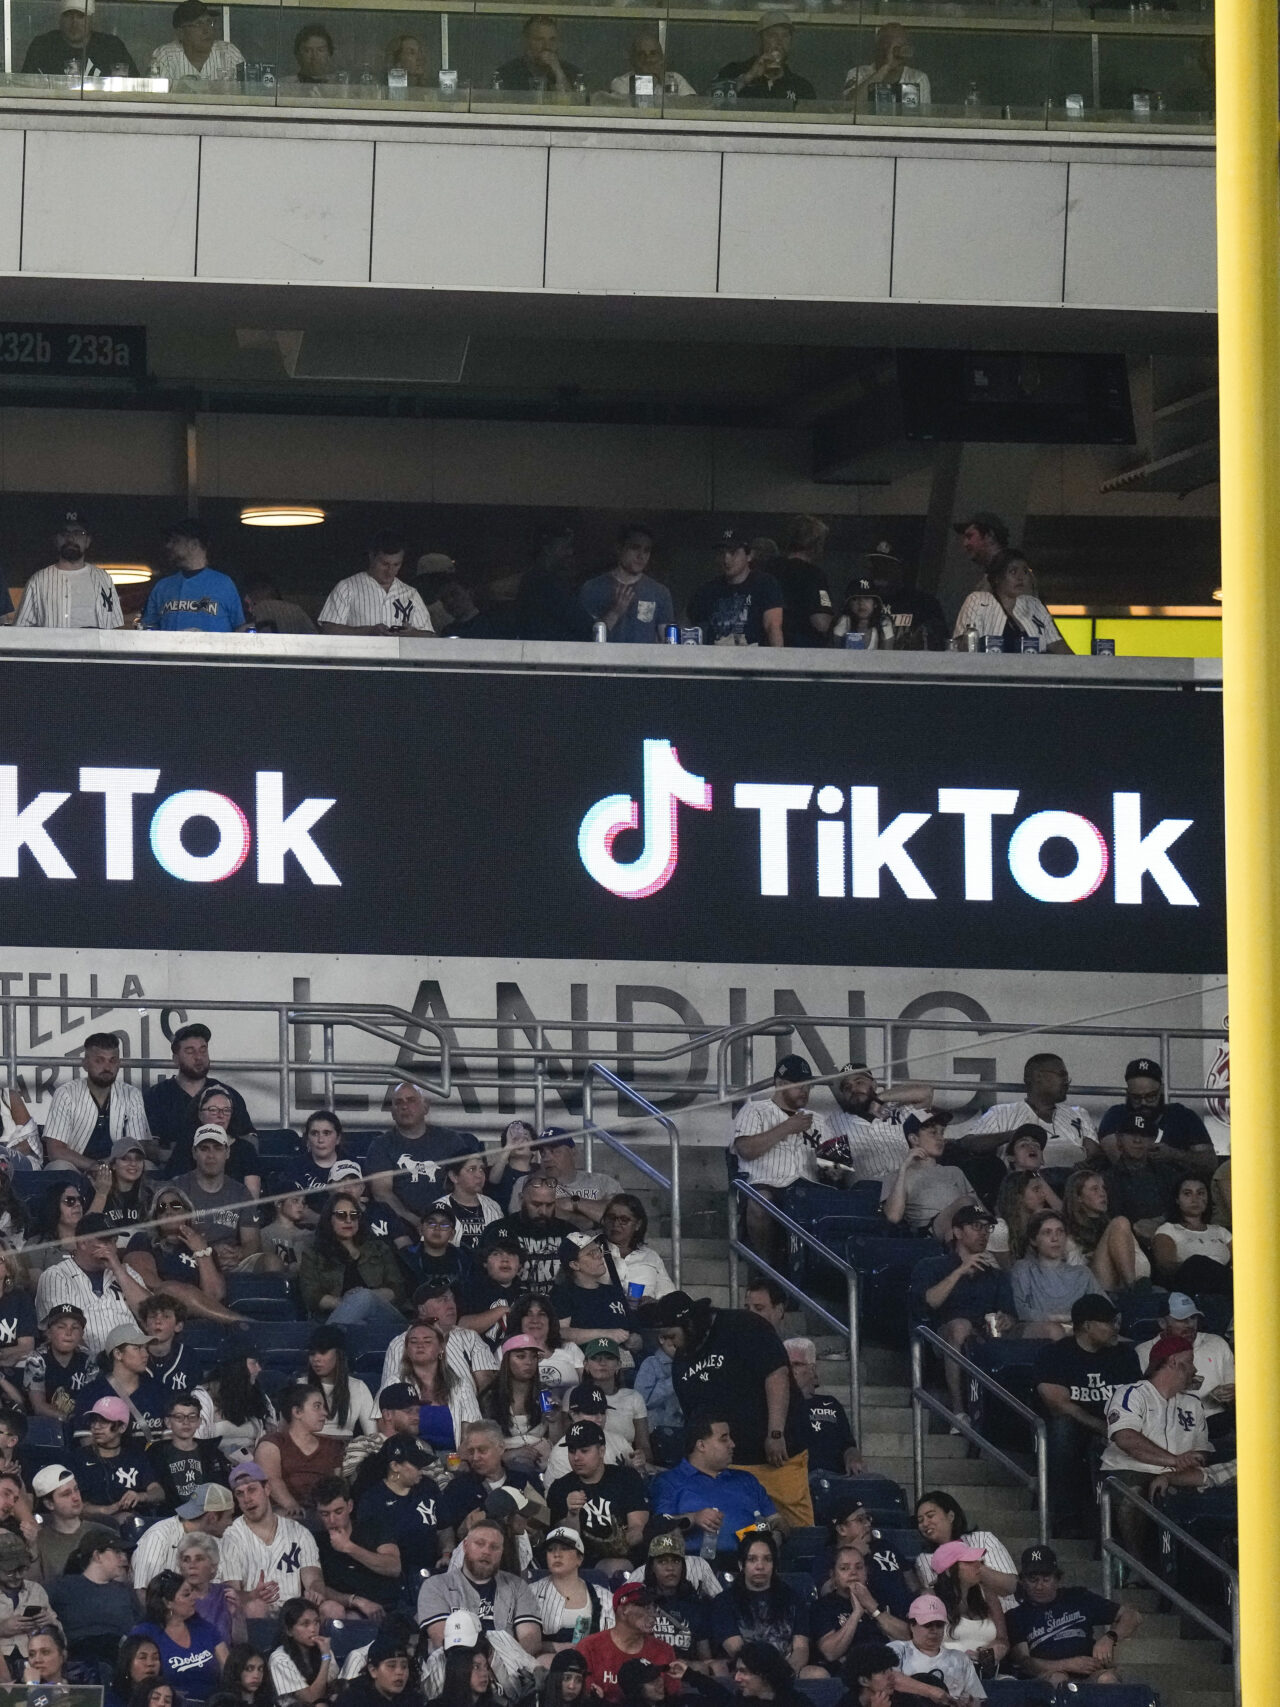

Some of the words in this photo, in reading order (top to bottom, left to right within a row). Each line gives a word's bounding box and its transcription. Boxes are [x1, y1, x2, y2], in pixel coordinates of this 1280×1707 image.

[67, 335, 130, 366] 233a
[393, 599, 413, 623] NY
[734, 782, 1199, 908] TikTok
[293, 976, 998, 1128] LANDING
[0, 1318, 18, 1343] NY
[72, 1372, 86, 1390] NY
[172, 1372, 187, 1390] NY
[971, 1379, 980, 1401] NY
[1087, 1373, 1105, 1387] EL
[810, 1407, 837, 1418] YORK
[116, 1467, 138, 1488] NY
[416, 1500, 437, 1525] NY
[583, 1498, 612, 1527] NY
[1162, 1532, 1171, 1554] NY
[277, 1543, 301, 1573] NY
[873, 1550, 899, 1571] NY
[1047, 1612, 1084, 1633] Stadium
[168, 1649, 214, 1672] Dodgers
